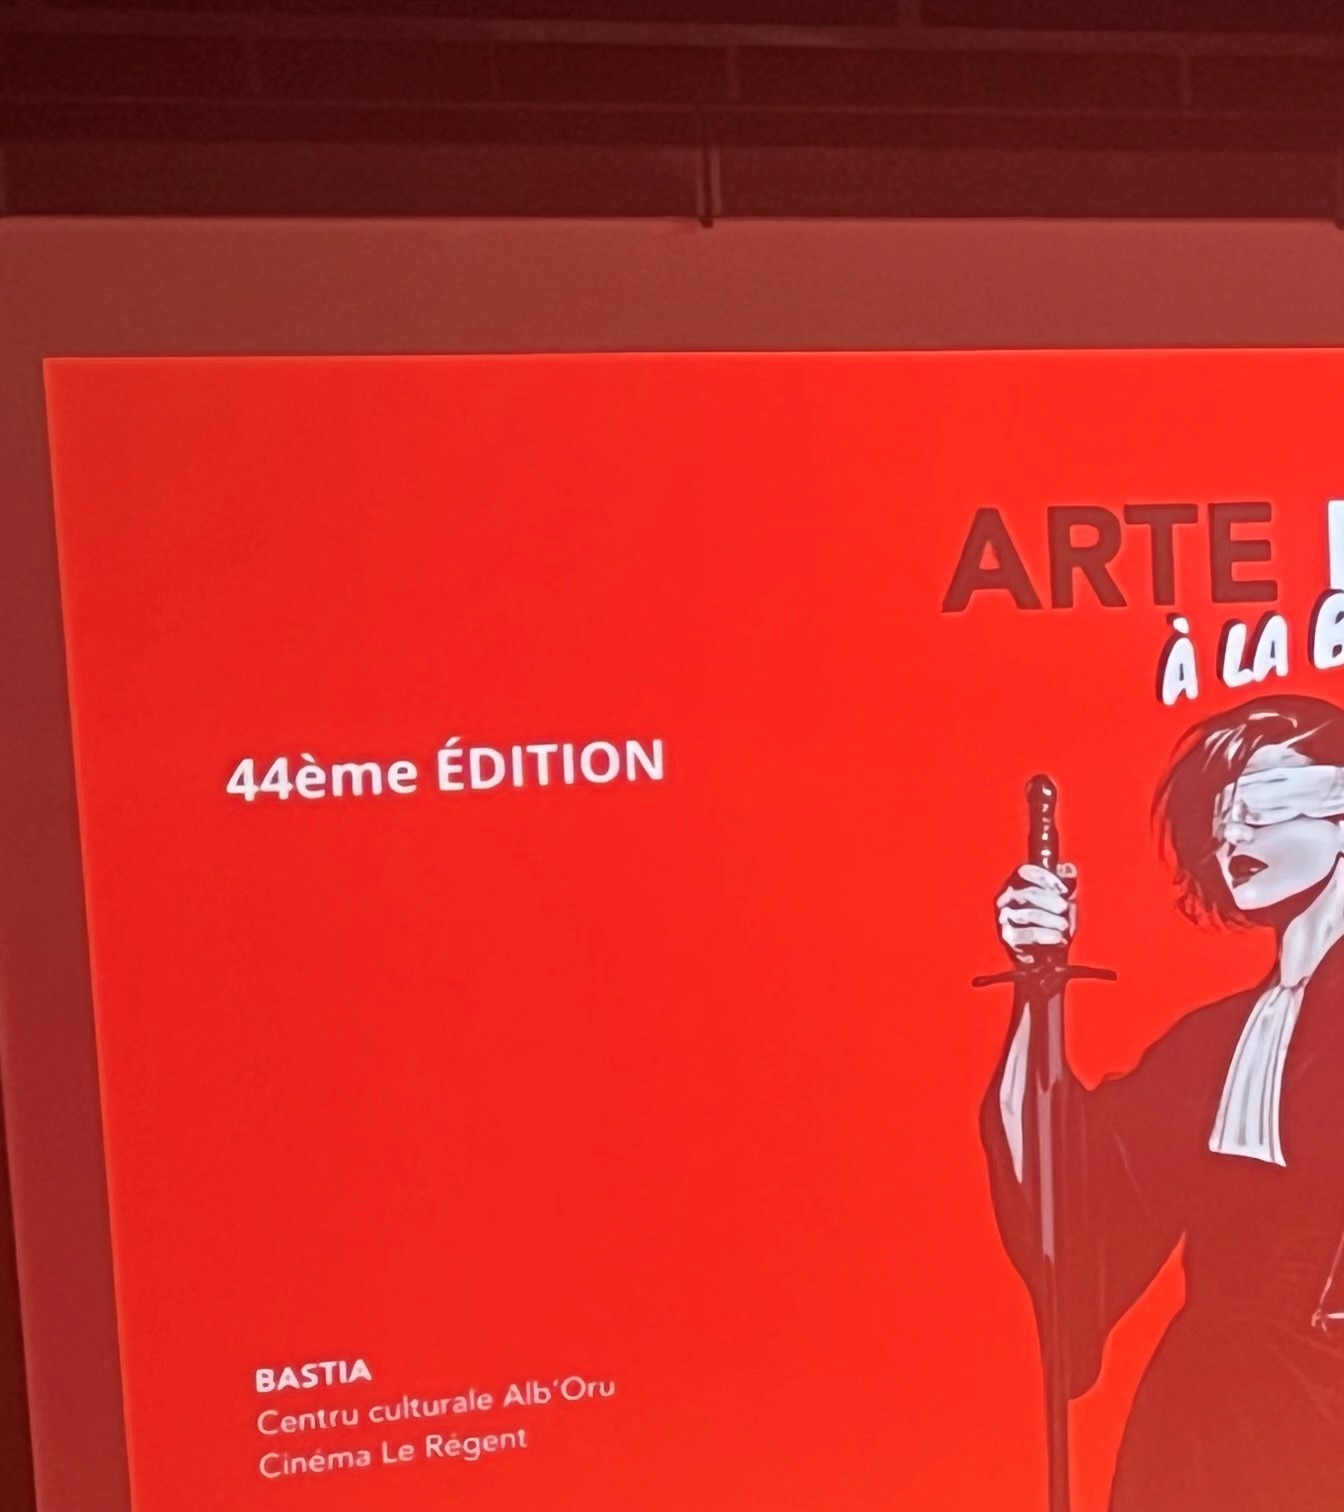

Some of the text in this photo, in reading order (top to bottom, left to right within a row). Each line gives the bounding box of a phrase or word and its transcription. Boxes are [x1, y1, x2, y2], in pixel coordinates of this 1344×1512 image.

[941, 501, 1277, 613] ARTE
[1156, 614, 1199, 706] À
[1217, 613, 1290, 688] LA
[226, 736, 665, 802] 44ème ÉDITION
[255, 1358, 373, 1394] BASTIA
[257, 1375, 616, 1436] Centru culturale Alb'Oru
[259, 1428, 528, 1479] Cinéma Le Régent
